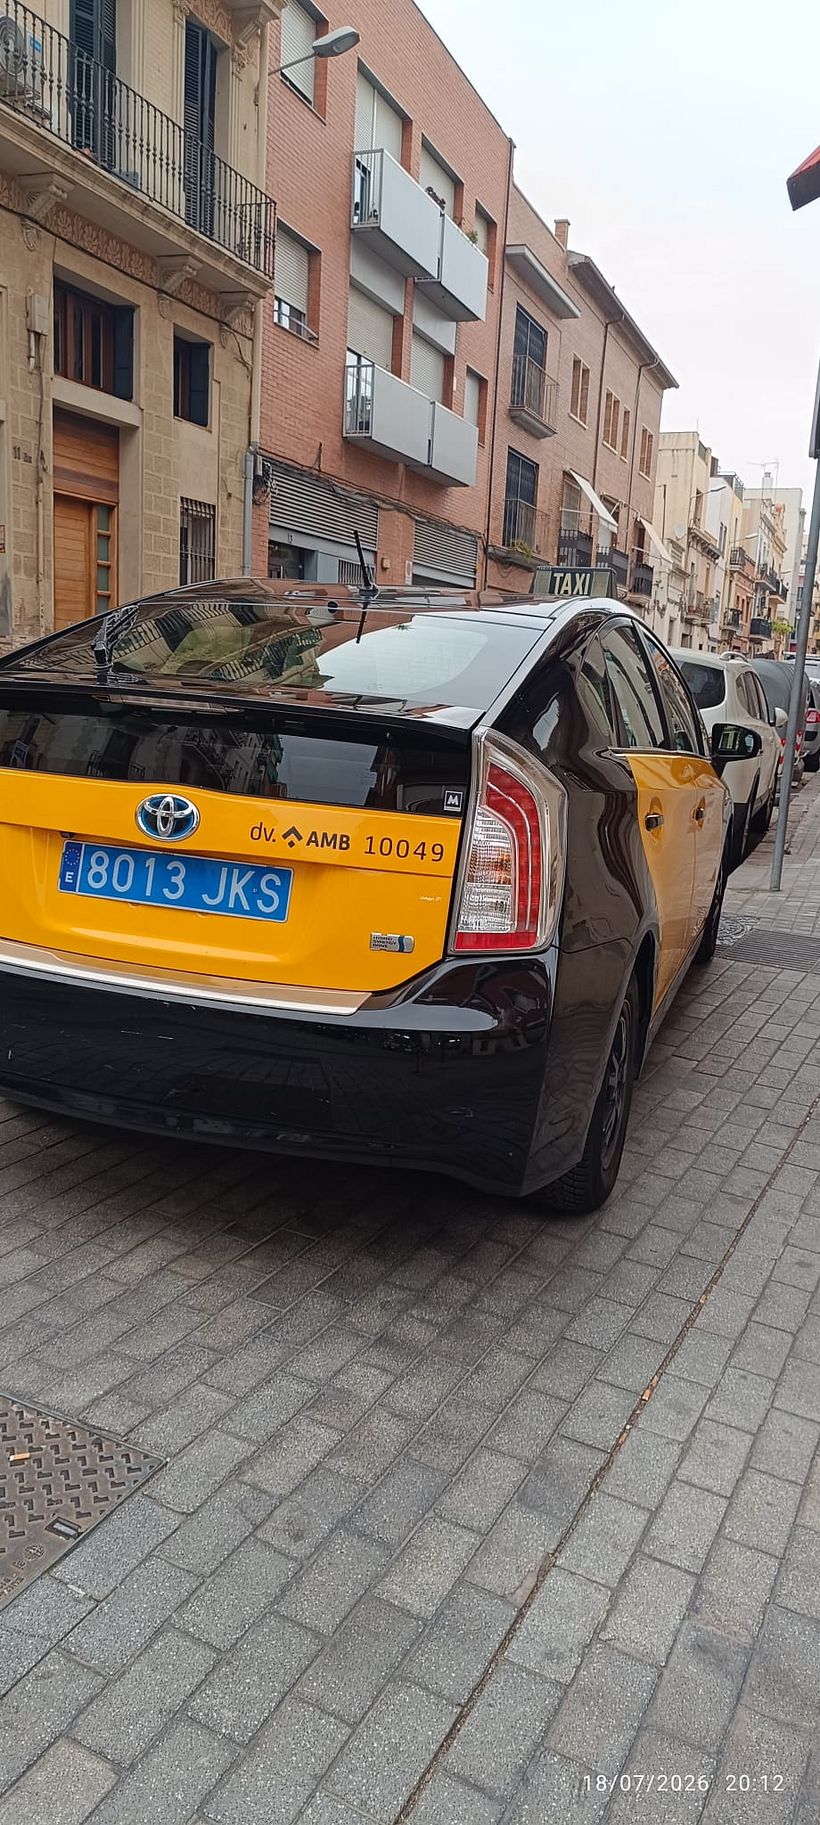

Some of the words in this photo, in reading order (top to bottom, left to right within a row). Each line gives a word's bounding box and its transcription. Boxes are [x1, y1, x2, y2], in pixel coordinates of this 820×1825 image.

[553, 572, 591, 596] TAXI
[447, 794, 459, 805] M
[250, 822, 276, 843] dv.
[306, 831, 350, 851] AMB
[364, 835, 445, 862] 10049
[65, 872, 74, 883] E
[87, 851, 186, 900] 8013
[201, 867, 282, 914] JKS
